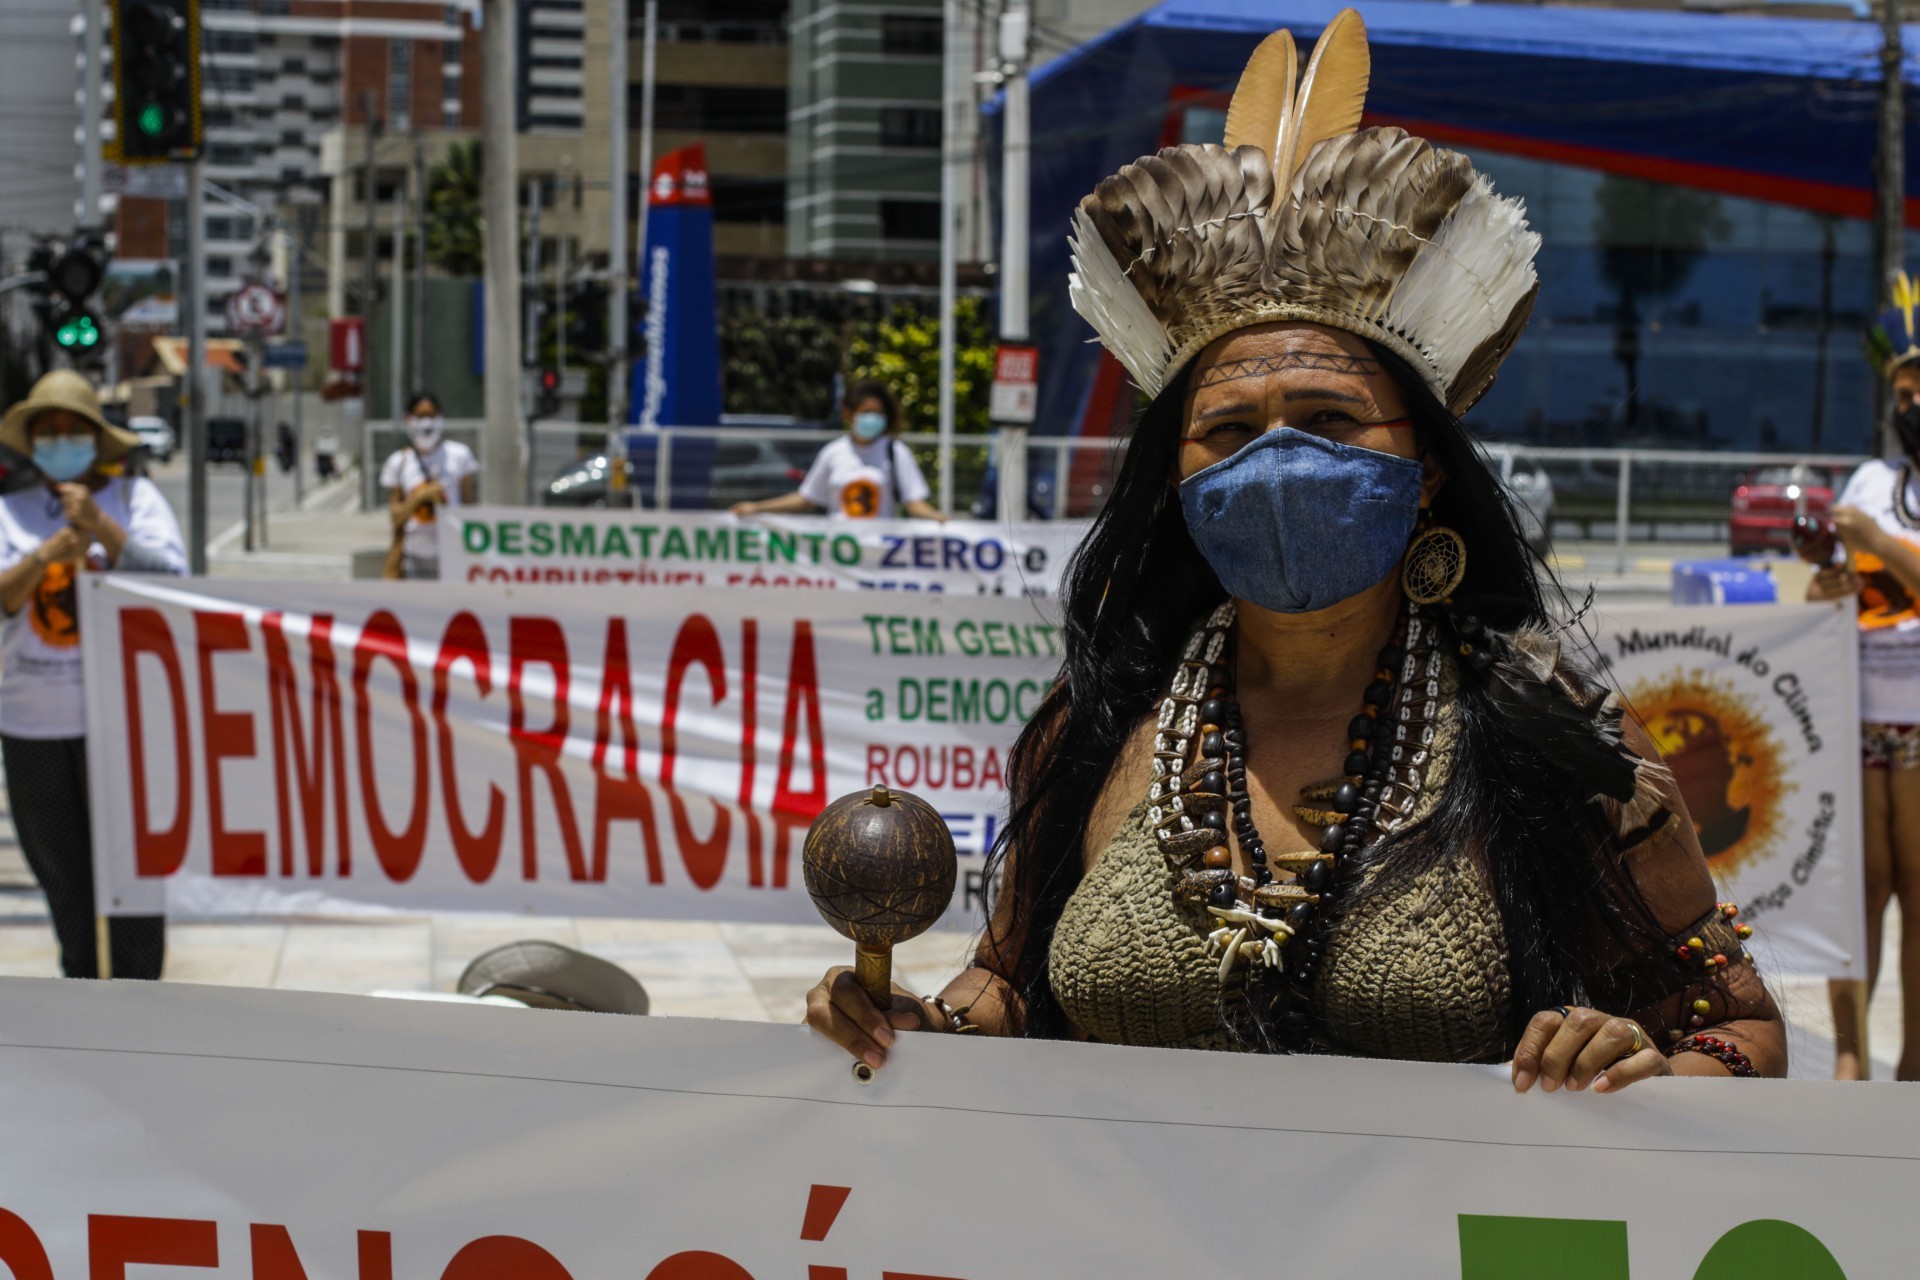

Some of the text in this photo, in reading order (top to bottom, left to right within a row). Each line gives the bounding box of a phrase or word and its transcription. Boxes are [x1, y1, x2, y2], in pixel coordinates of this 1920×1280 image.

[462, 520, 1048, 572] DESMATAMENTO ZERO e
[862, 614, 1065, 657] TEM GENT
[866, 677, 1052, 725] a DEMOC
[1614, 627, 1824, 755] Mundial do Clima
[118, 606, 828, 891] DEMOCRACIA
